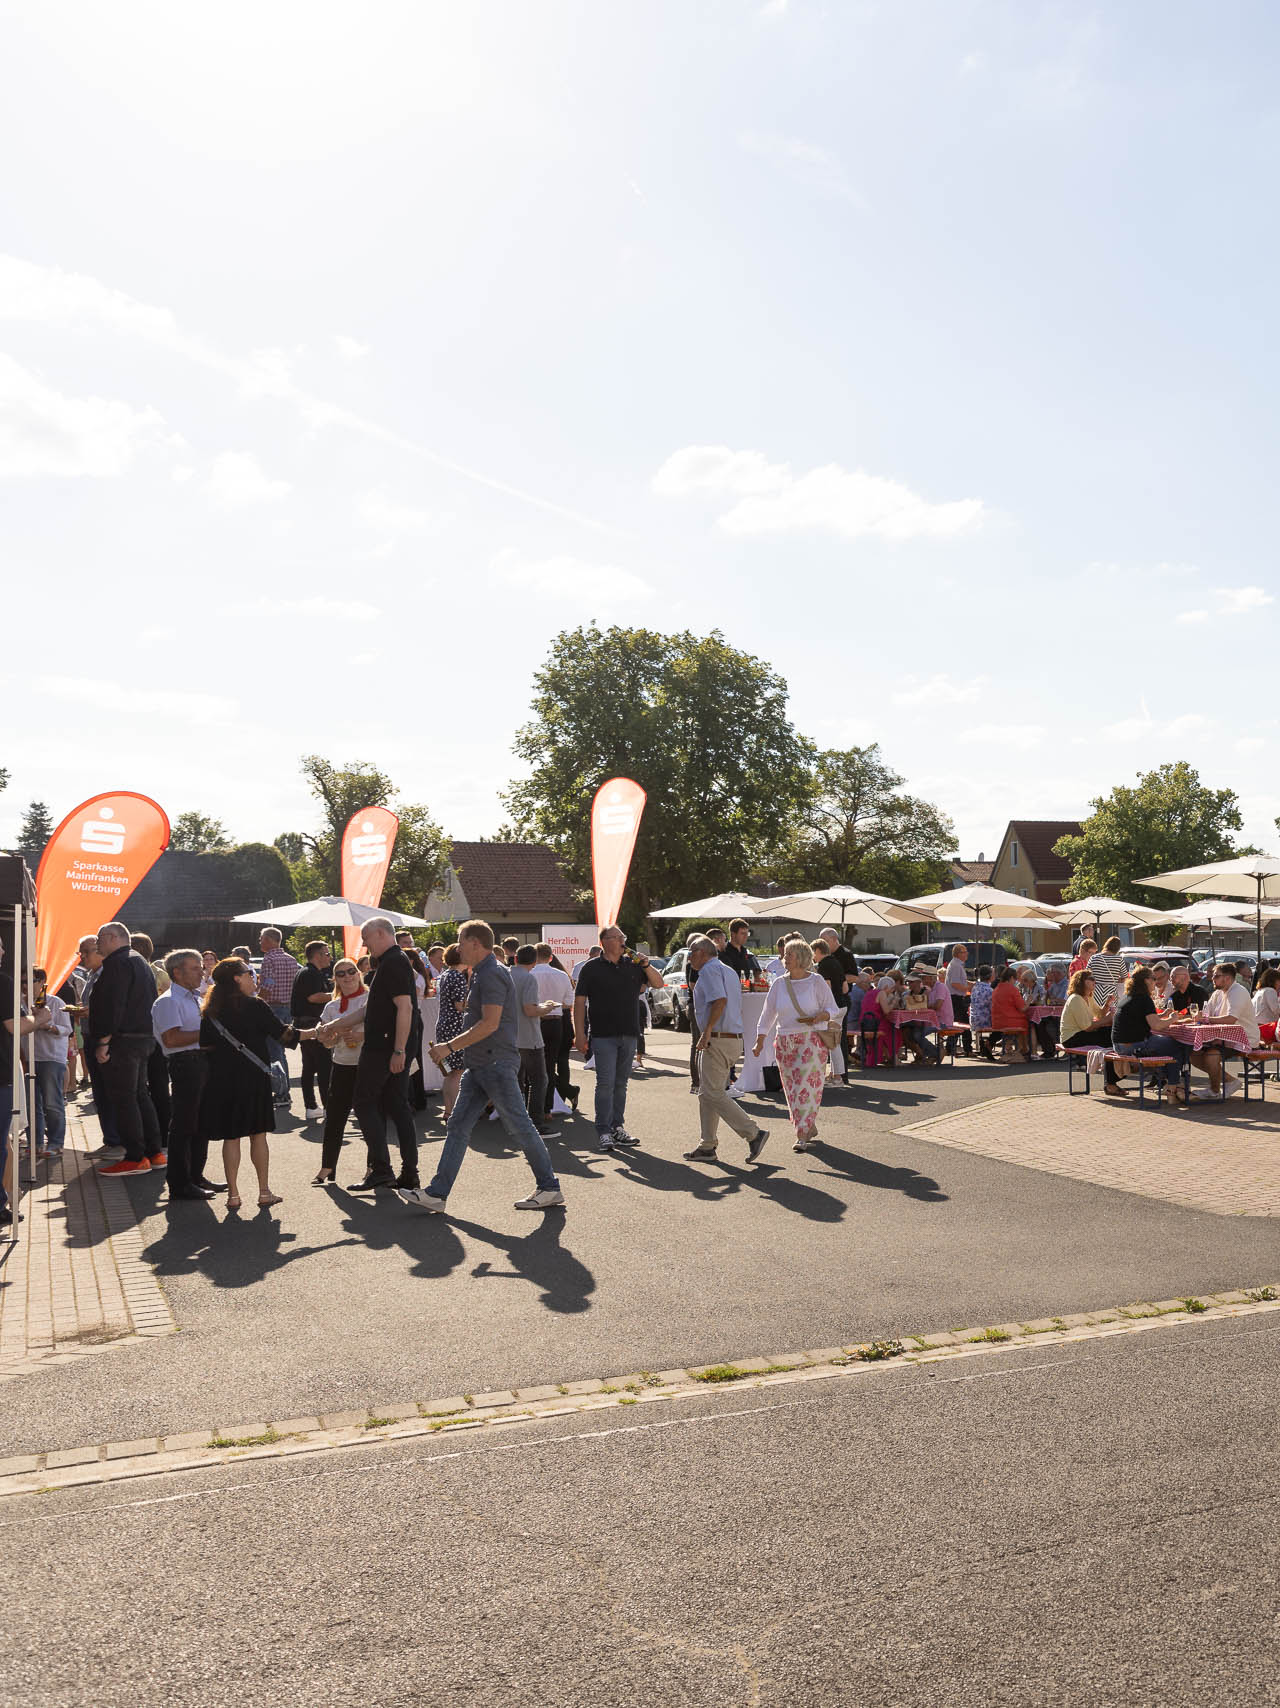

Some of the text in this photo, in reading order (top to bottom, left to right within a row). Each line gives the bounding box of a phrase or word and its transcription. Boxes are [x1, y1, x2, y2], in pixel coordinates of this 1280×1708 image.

[73, 860, 124, 873] Sparkasse
[65, 870, 129, 884] Mainfranken
[71, 881, 121, 895] Würzburg
[547, 936, 580, 945] Herzlich
